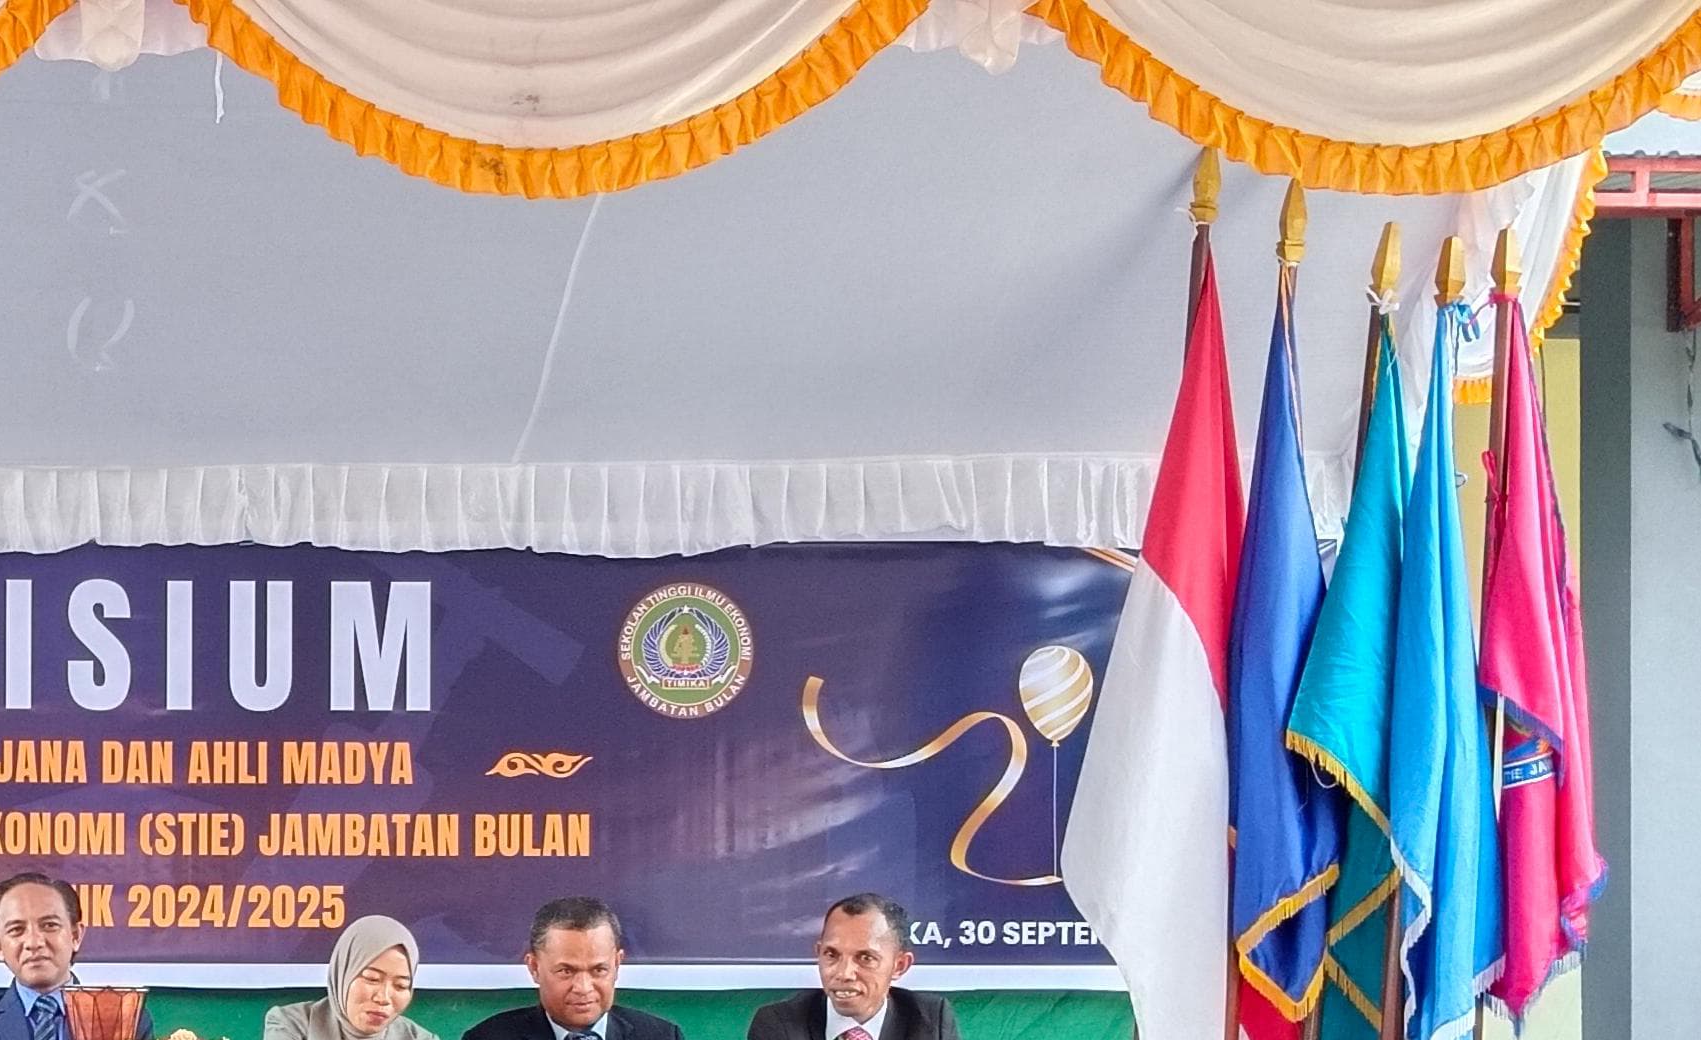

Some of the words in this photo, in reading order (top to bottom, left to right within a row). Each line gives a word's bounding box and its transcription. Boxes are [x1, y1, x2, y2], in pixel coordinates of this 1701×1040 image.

[646, 586, 691, 606] TINGGI
[694, 587, 726, 606] ILMU
[724, 603, 752, 661] EKONOMI
[627, 676, 699, 717] JAMBATAN
[704, 675, 747, 713] BULAN
[666, 679, 706, 688] TIMIKA
[102, 740, 173, 784] DAN
[187, 741, 268, 785] AHLI
[282, 741, 414, 785] MADYA
[139, 812, 245, 857] (STIE)
[259, 813, 460, 858] JAMBATAN
[474, 813, 591, 858] BULAN
[127, 884, 346, 929] 2024/2025
[909, 921, 952, 949] KA,
[958, 919, 996, 945] 30
